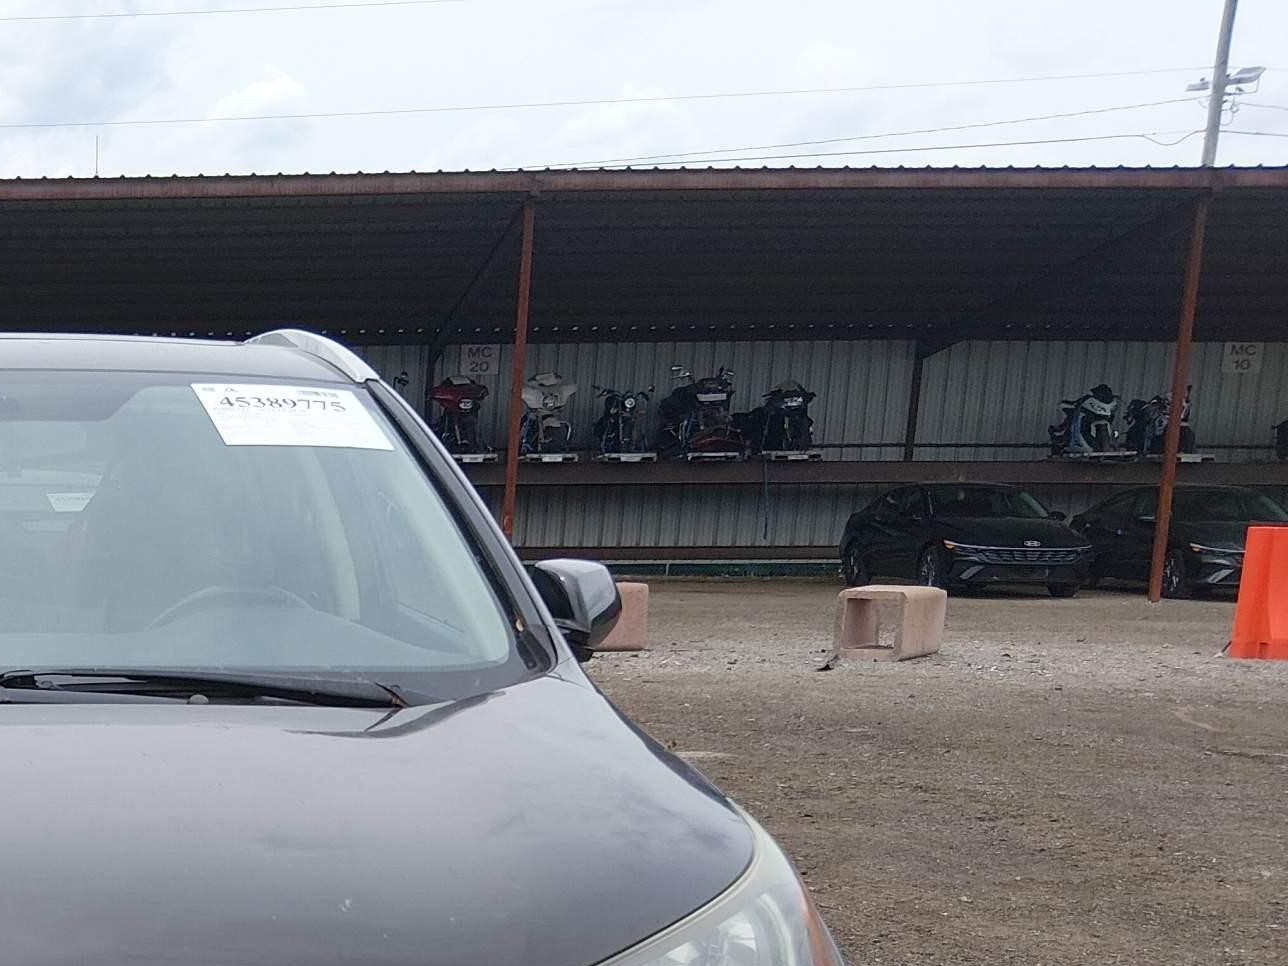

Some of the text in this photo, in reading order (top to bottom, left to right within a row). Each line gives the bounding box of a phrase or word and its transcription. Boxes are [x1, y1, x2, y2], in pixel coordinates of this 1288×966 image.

[467, 346, 492, 358] MC
[1231, 344, 1256, 355] MC
[469, 361, 489, 373] 20
[1233, 359, 1251, 370] 10
[219, 396, 346, 412] 45389775
